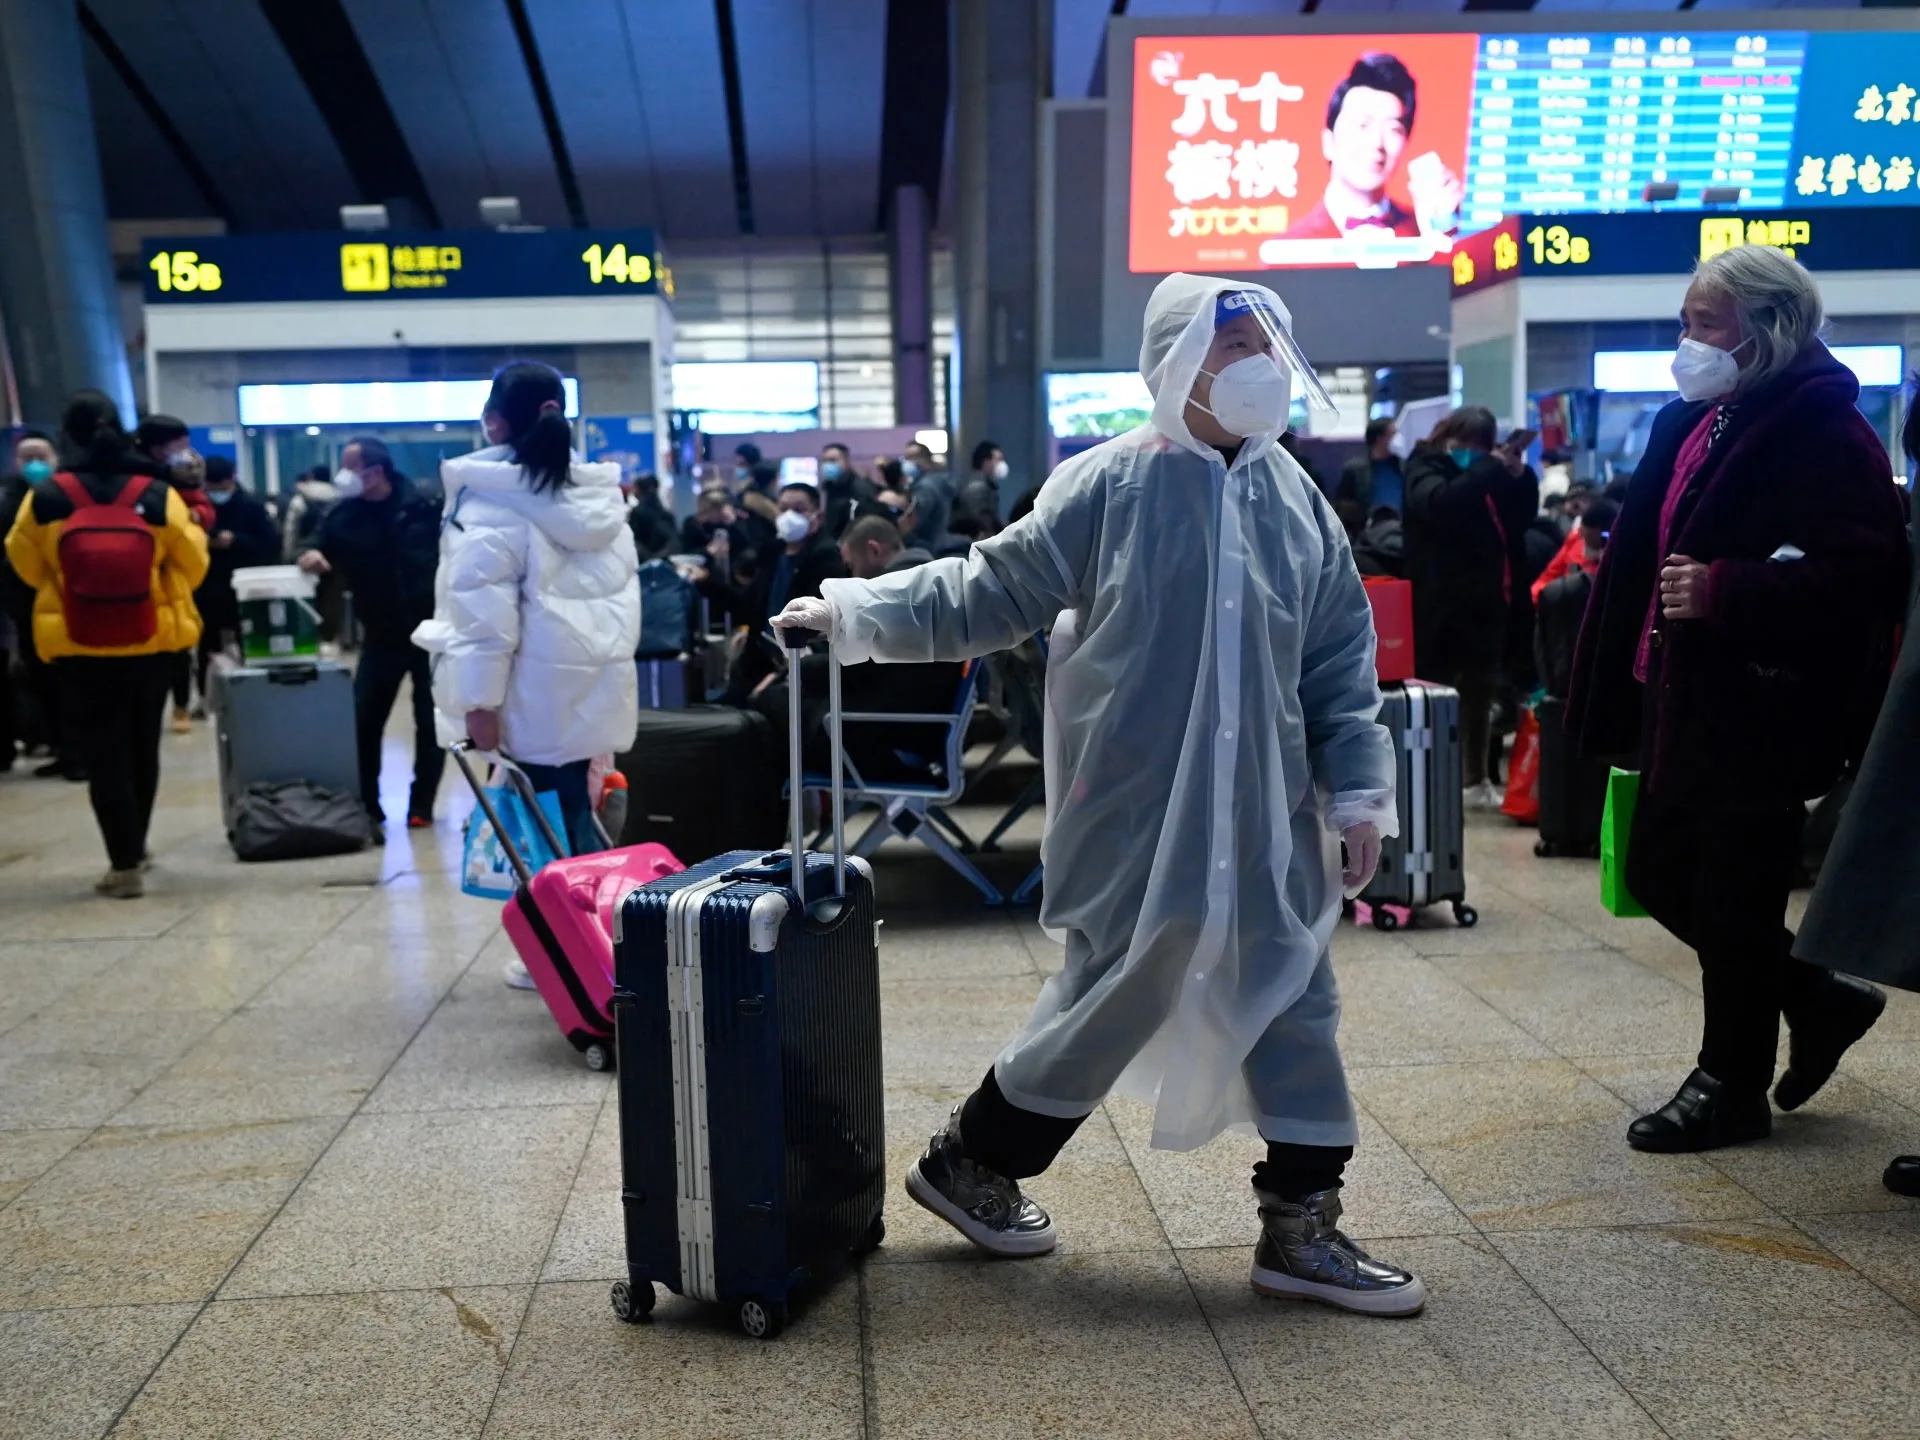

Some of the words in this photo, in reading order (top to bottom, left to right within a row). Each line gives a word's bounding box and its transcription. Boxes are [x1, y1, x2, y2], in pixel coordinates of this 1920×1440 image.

[582, 243, 651, 283] 14B
[1527, 225, 1590, 264] 13B
[150, 252, 222, 292] 15B
